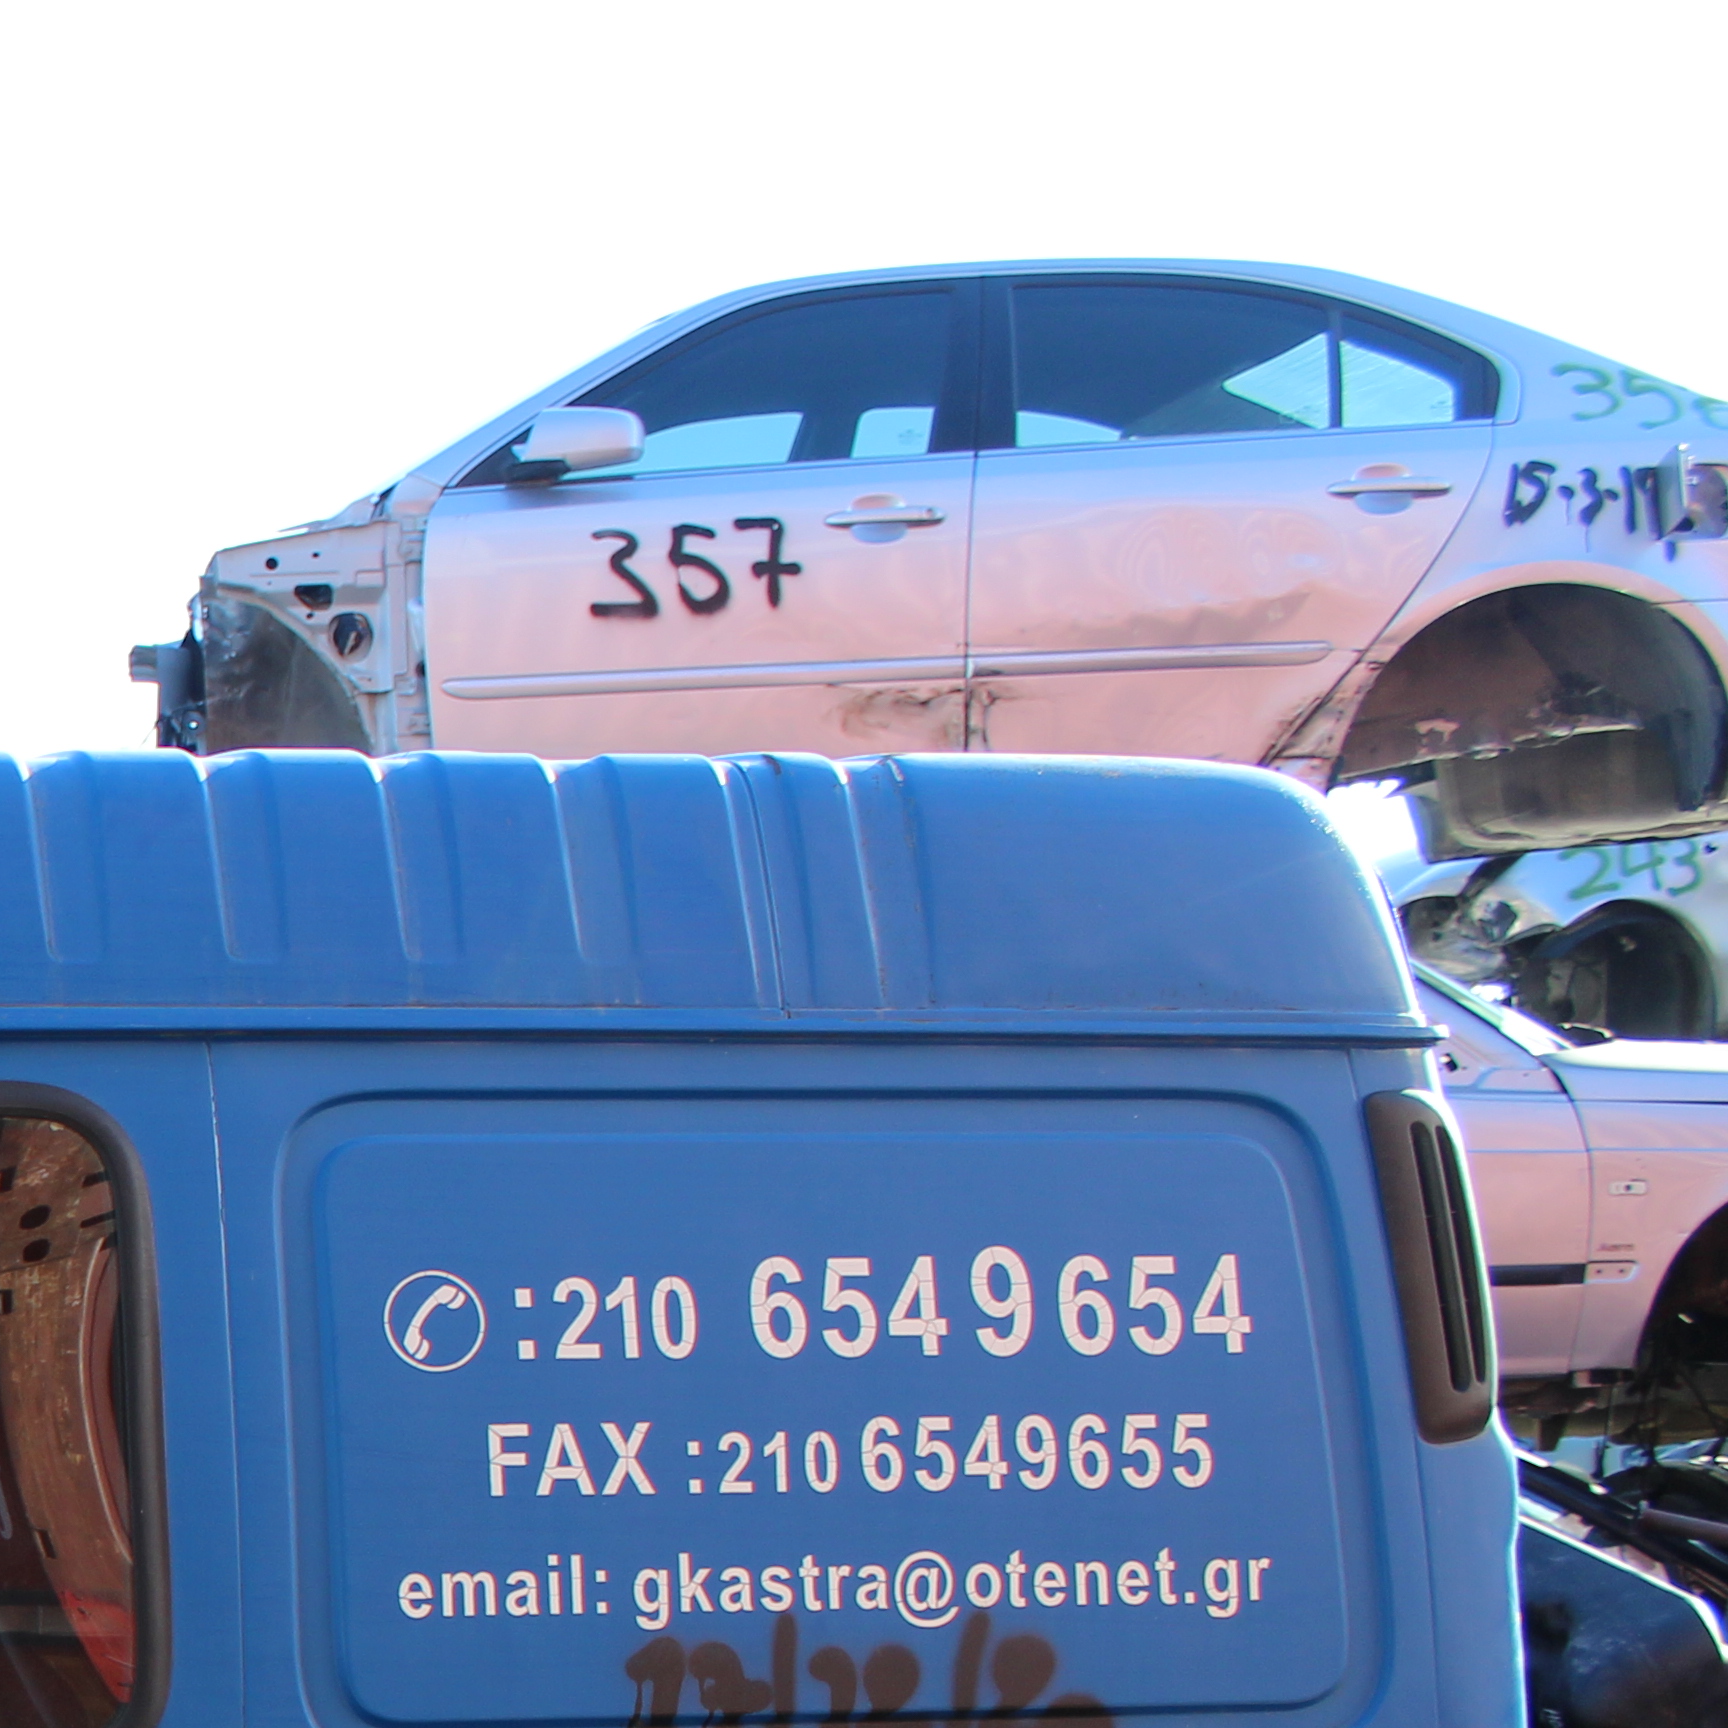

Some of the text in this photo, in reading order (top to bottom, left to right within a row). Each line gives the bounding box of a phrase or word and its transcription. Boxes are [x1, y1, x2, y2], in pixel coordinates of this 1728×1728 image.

[590, 516, 802, 617] 357
[1558, 840, 1702, 900] 243
[488, 1421, 657, 1497] FAX
[861, 1413, 1215, 1492] 6549655
[399, 1547, 1273, 1631] email: gkastra@otenet.gr
